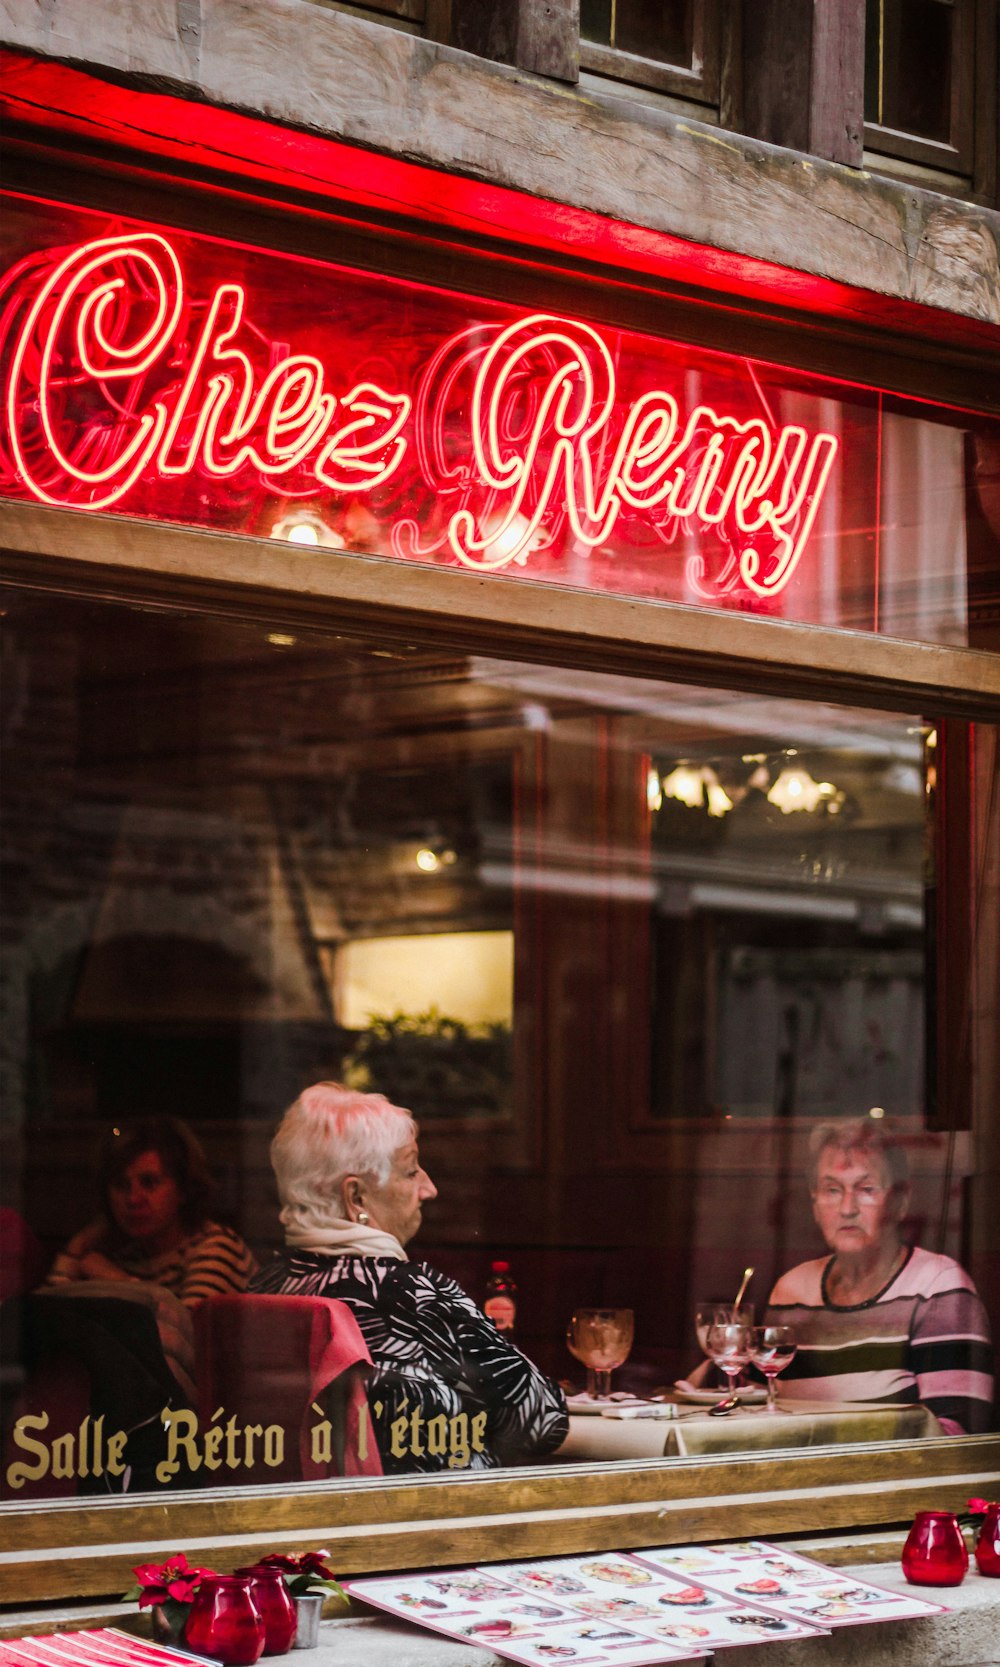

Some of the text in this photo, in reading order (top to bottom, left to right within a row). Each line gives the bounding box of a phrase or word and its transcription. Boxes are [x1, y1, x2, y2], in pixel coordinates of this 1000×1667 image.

[7, 231, 839, 596] Chez Remy
[6, 1400, 488, 1489] Salle Rétro à l'étage
